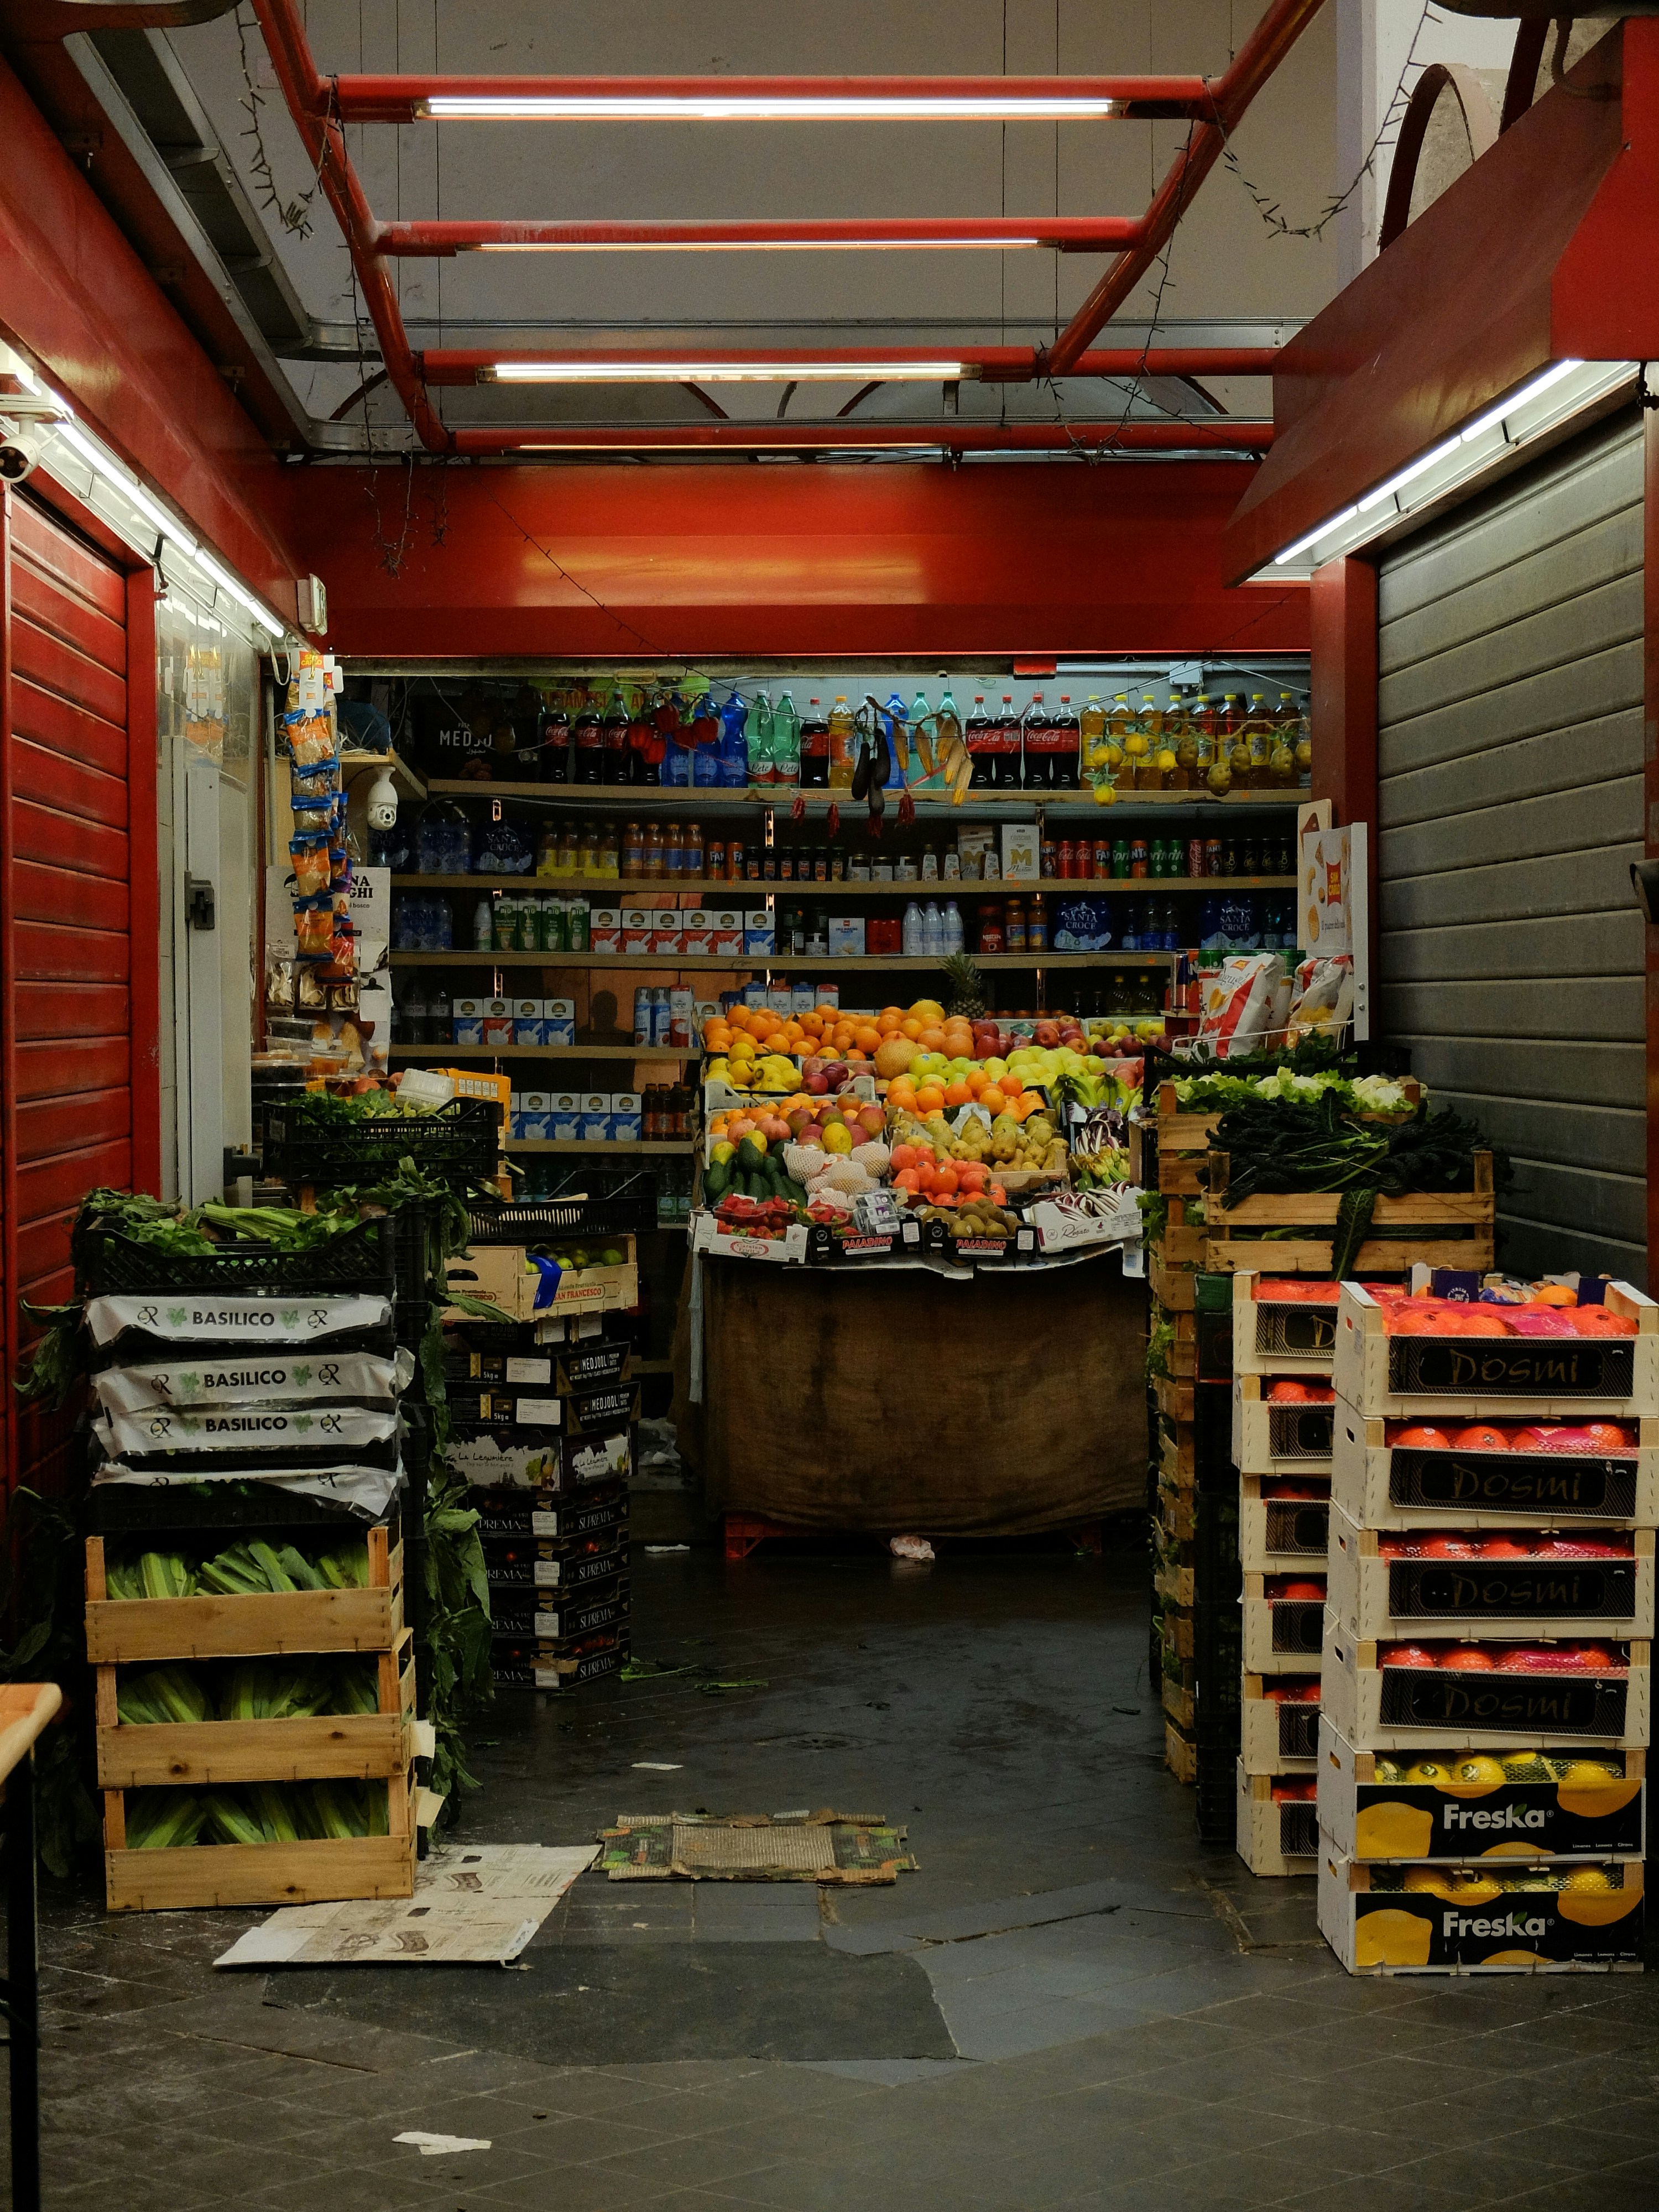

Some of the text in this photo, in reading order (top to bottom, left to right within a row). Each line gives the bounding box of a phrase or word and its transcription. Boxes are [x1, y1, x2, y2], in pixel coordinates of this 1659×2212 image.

[1063, 913, 1098, 924] SANTA
[1065, 921, 1097, 930] CROCE
[1219, 915, 1251, 925] SANTA
[1222, 923, 1250, 932] CROCE
[842, 1235, 894, 1250] PALADINO
[956, 1239, 1007, 1250] PALADINO
[193, 1311, 275, 1326] BASILICO
[1308, 1314, 1336, 1348] D
[582, 1354, 607, 1371] MEDJOOL
[204, 1370, 286, 1388] BASILICO
[483, 1371, 494, 1381] 5kg
[592, 1395, 618, 1411] MEDJOOL
[206, 1416, 288, 1433] BASILICO
[494, 1412, 504, 1422] 5kg
[477, 1519, 521, 1530] PREMA
[578, 1510, 611, 1531] SUPREMA
[487, 1569, 523, 1580] REMA
[579, 1559, 611, 1580] SUPREMA
[580, 1608, 612, 1629] SUPREMA
[580, 1657, 612, 1679] SUPREMA
[1443, 1803, 1546, 1829] Freska
[1443, 1911, 1546, 1937] Freska
